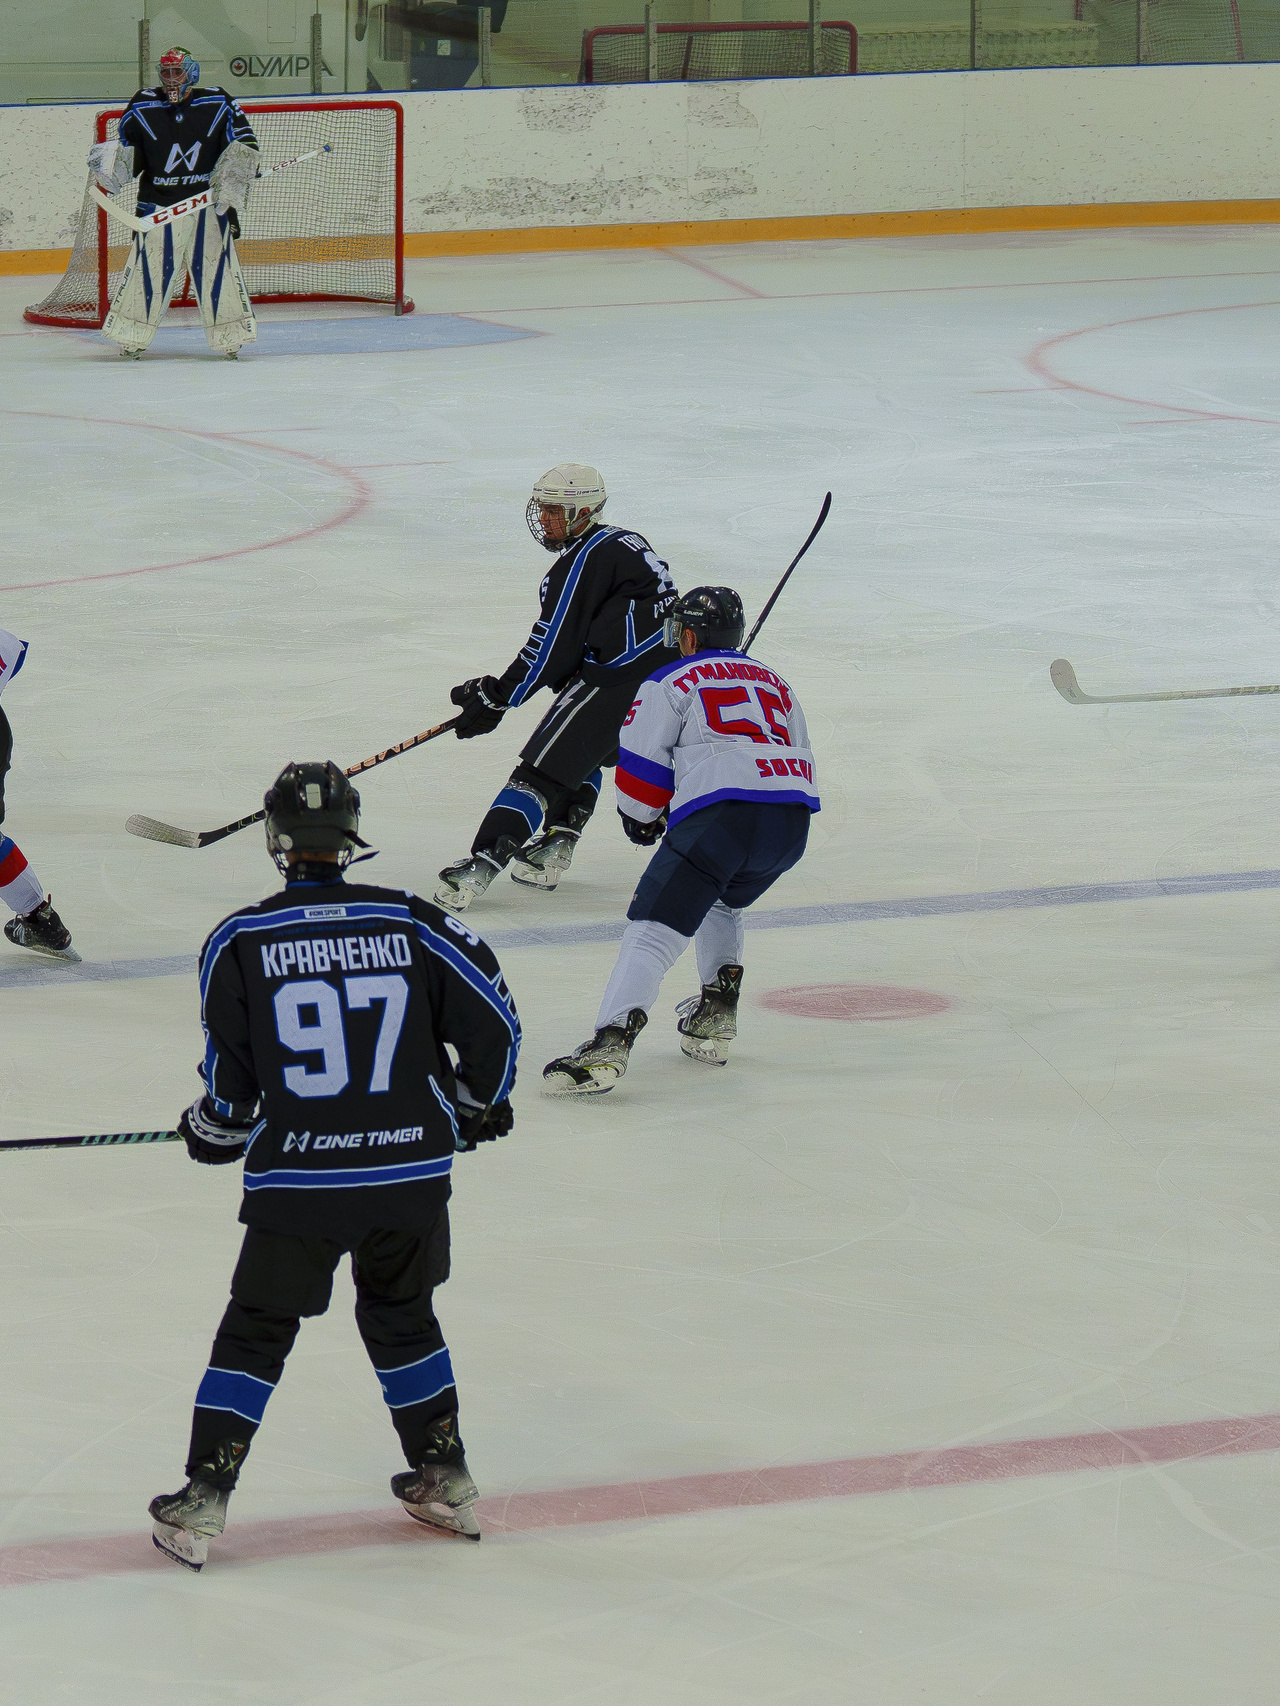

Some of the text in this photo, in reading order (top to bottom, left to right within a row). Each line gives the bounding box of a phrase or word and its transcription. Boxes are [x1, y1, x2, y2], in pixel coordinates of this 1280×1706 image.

[182, 173, 212, 184] TIME
[153, 194, 208, 223] CCM
[755, 758, 813, 785] SOCHI
[260, 933, 413, 978] КРАВЧЕНКО
[273, 973, 410, 1098] 97
[313, 1126, 424, 1150] ONE TIMER
